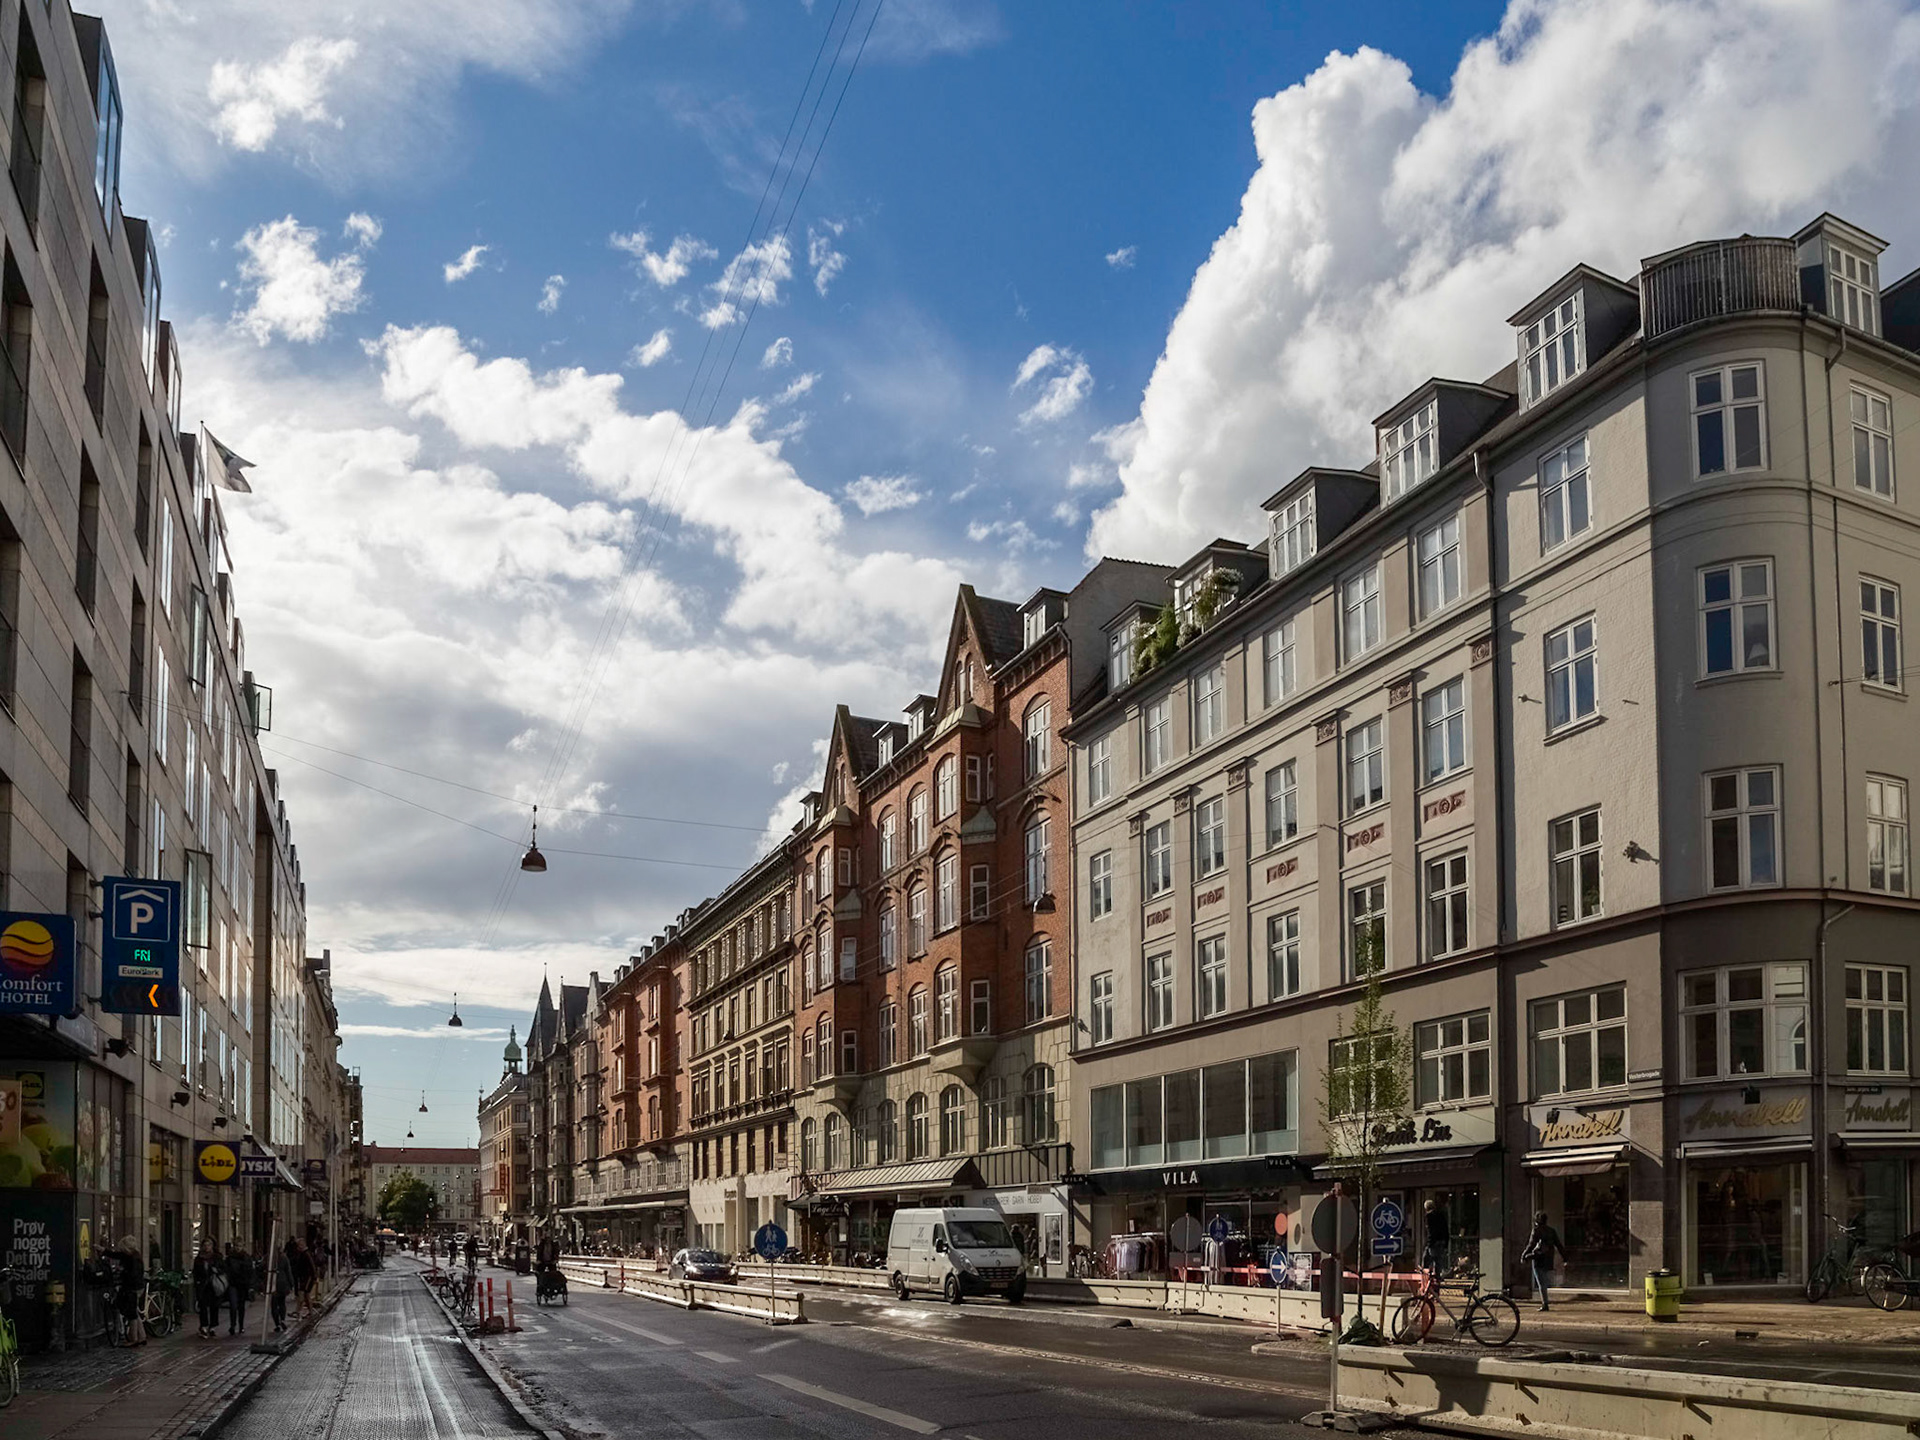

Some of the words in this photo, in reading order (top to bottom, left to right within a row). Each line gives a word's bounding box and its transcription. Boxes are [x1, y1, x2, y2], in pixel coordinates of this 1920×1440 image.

[130, 902, 154, 934] P
[134, 949, 151, 962] FRI
[0, 973, 64, 992] omfort
[0, 991, 53, 1005] HOTEL
[1684, 1097, 1807, 1133] Annabell
[1845, 1091, 1910, 1124] Annabell
[1540, 1109, 1625, 1144] Annabell
[240, 1160, 274, 1172] JYSK
[1163, 1171, 1198, 1185] VILA
[13, 1218, 46, 1237] Prøv
[13, 1234, 51, 1253] noget
[6, 1250, 28, 1266] Det
[29, 1250, 51, 1268] nyt
[15, 1281, 36, 1299] sig
